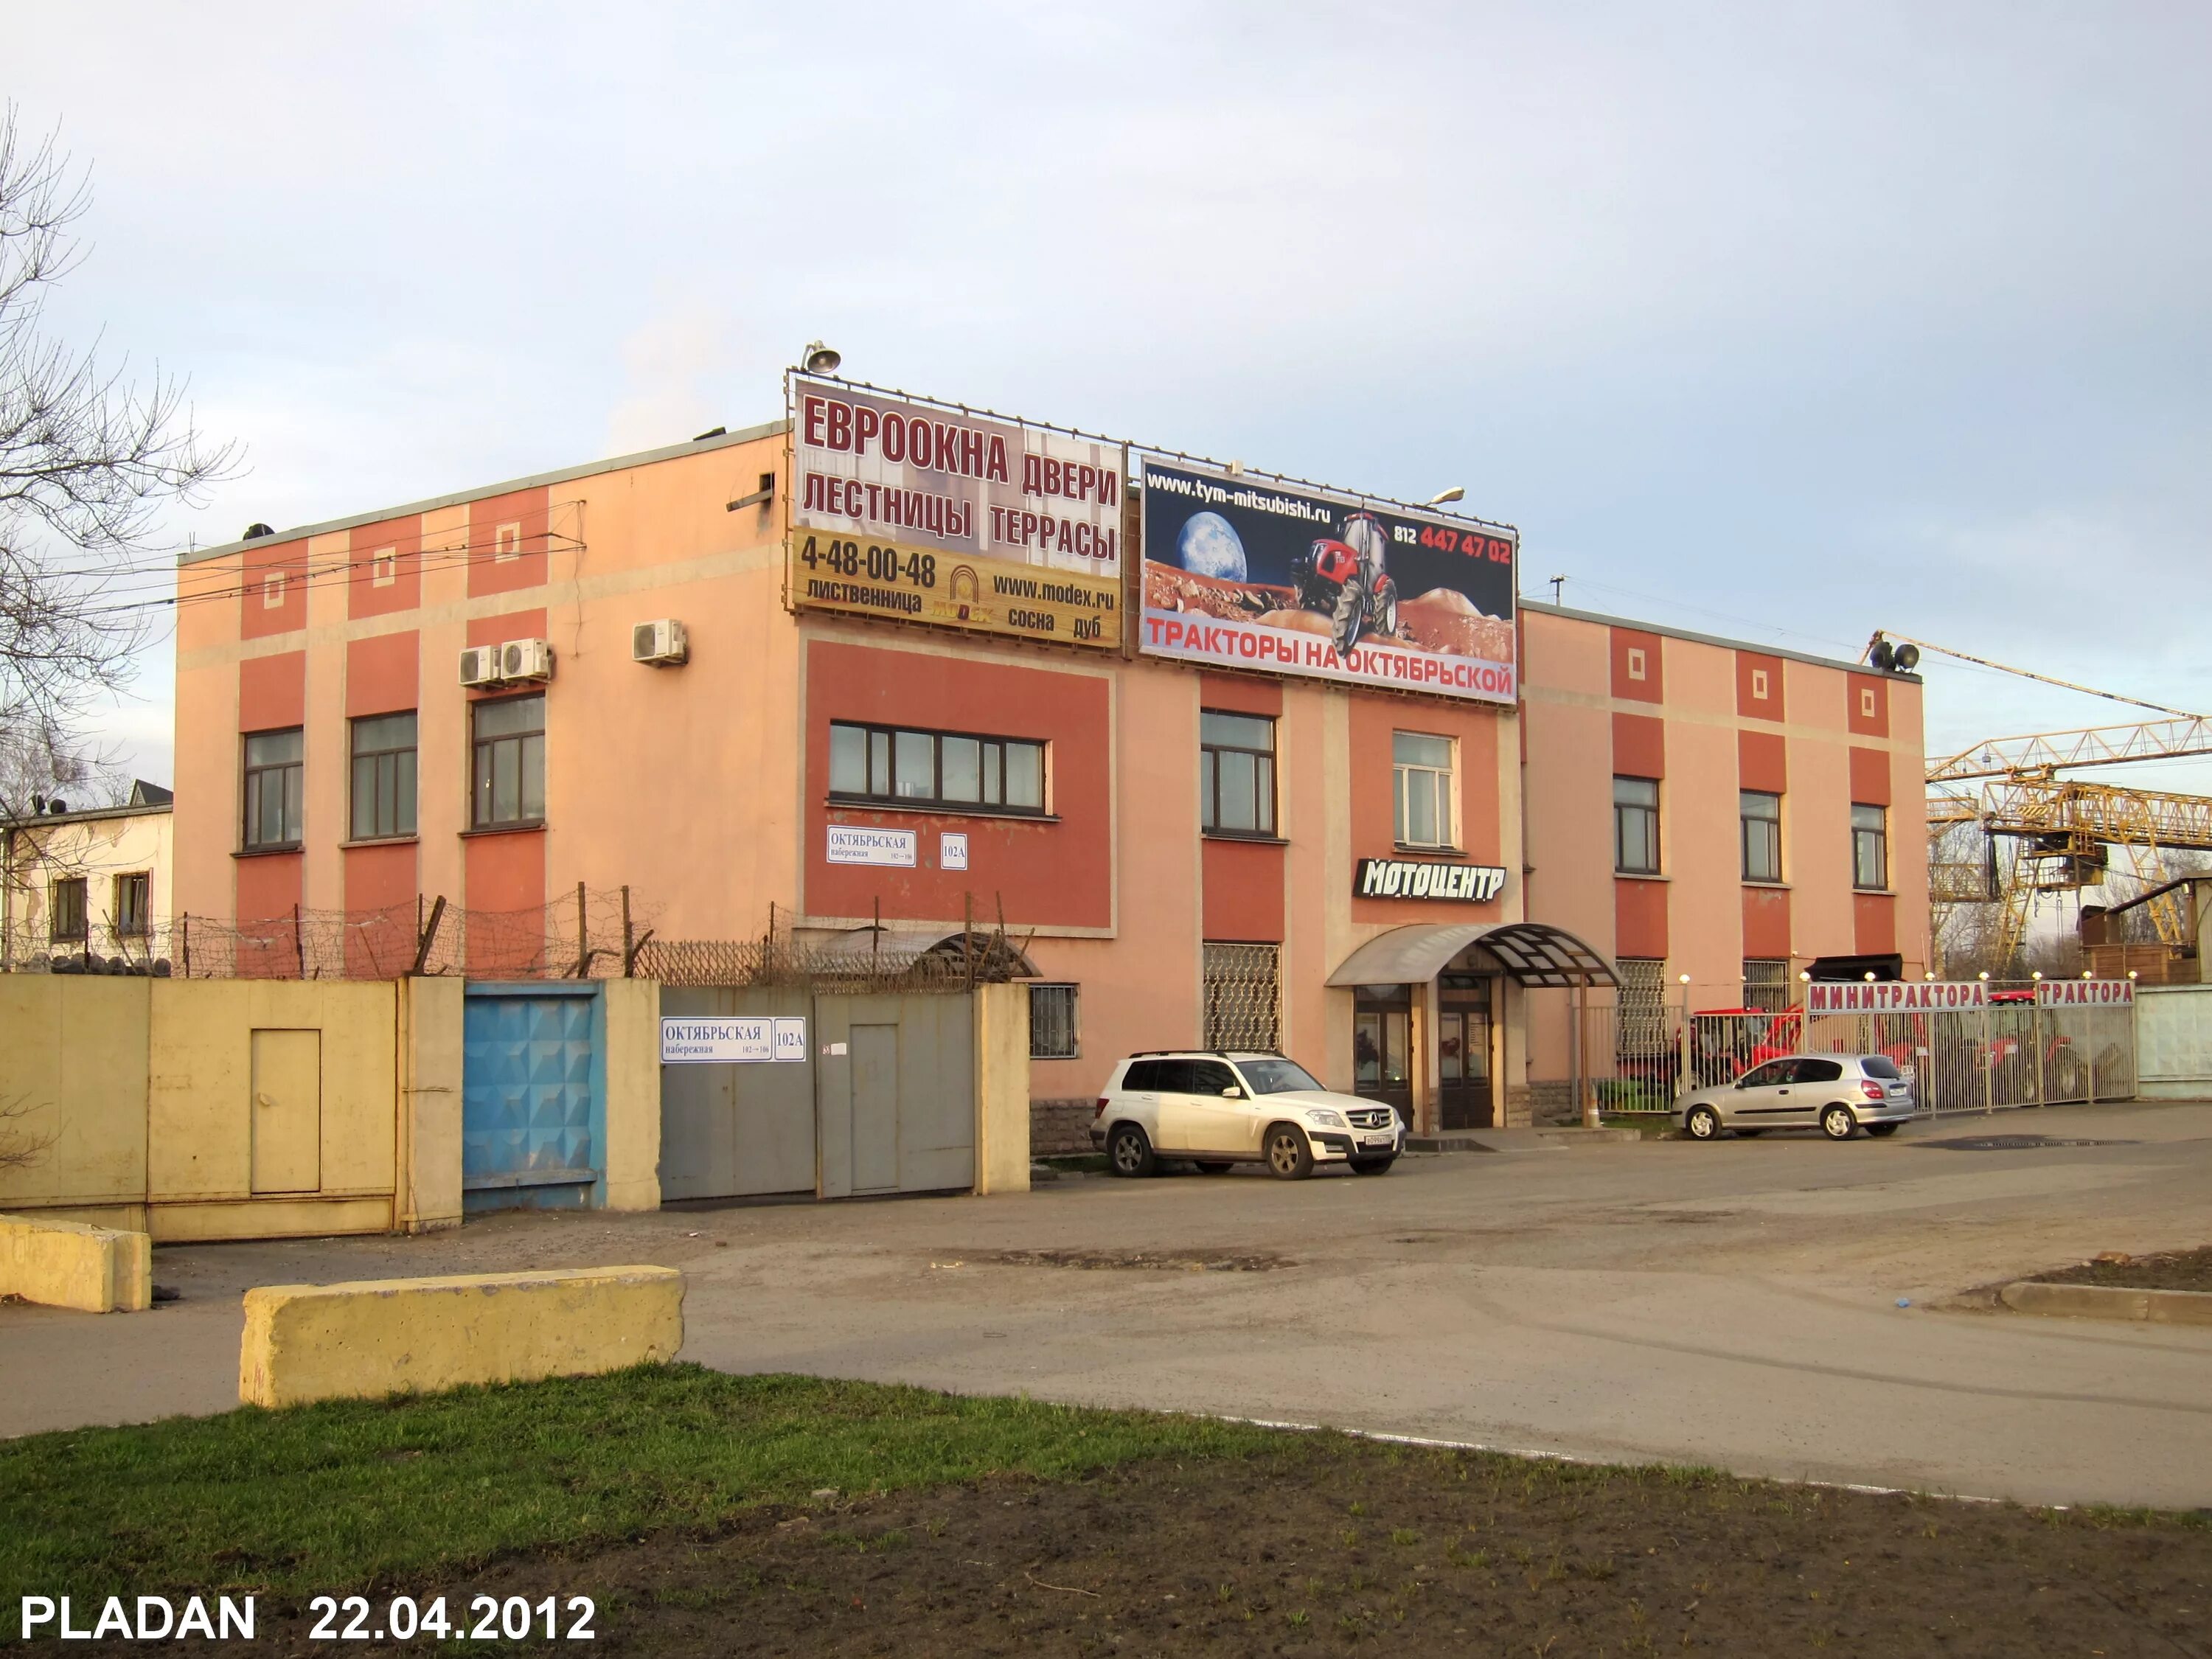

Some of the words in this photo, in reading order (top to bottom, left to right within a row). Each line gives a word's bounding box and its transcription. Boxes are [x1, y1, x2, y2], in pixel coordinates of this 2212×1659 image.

[804, 395, 1009, 484] ЕВРООКНА
[1022, 453, 1116, 507] ДВЕРИ
[1147, 473, 1331, 523] www.tym-mitsubishi.ru
[804, 473, 972, 538] ЛЕСТНИЦЫ
[990, 506, 1116, 561] ТЕРРАСЫ
[801, 536, 935, 588] 4-48-00-48
[1394, 526, 1416, 545] 812
[1421, 526, 1456, 553] 447
[1461, 535, 1483, 558] 47
[1489, 540, 1510, 564] 02
[807, 579, 922, 613] лиственница
[994, 575, 1114, 611] www.modex.ru
[1008, 606, 1054, 632] сосна
[1074, 615, 1101, 638] дуб
[1147, 617, 1299, 662] ТРАКТОРЫ
[1306, 641, 1340, 669] НА
[1346, 648, 1512, 695] ОКТЯБРЬСКОЙ
[831, 832, 906, 849] ОКТЯБРЬСКАЯ
[831, 848, 869, 858] набережная
[944, 846, 964, 858] 102А
[1363, 860, 1505, 900] МОТОЦЕНТР
[1810, 984, 1983, 1009] МИНИТРАКТОРА
[2040, 983, 2132, 1004] ТРАКТОРА
[665, 1026, 761, 1040] ОКТЯБРЬСКАЯ
[665, 1044, 713, 1056] набережная
[777, 1033, 803, 1046] 102А
